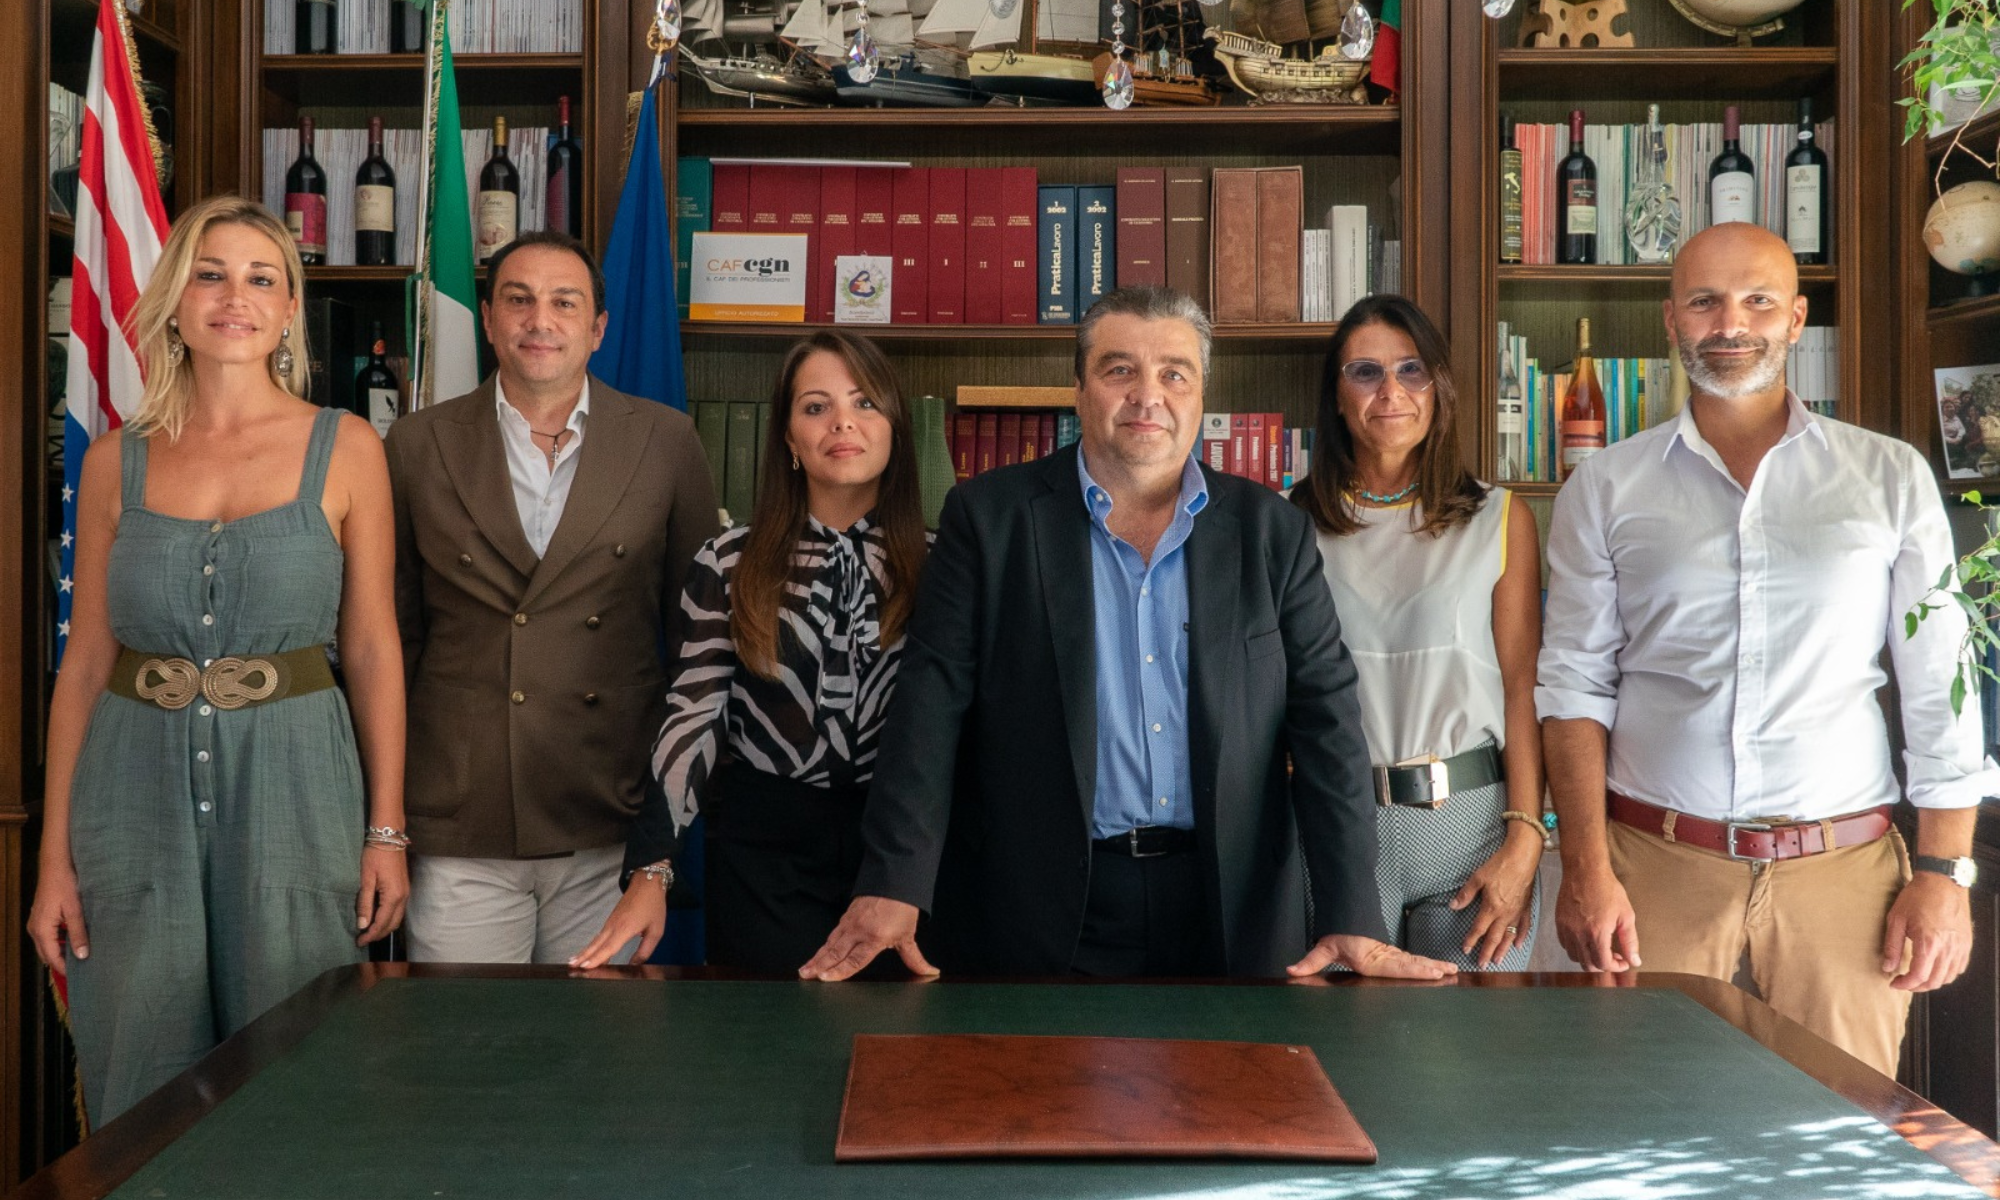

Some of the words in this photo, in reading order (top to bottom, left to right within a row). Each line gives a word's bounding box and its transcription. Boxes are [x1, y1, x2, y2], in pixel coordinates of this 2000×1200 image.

[1046, 206, 1067, 214] 2002
[903, 258, 915, 266] III
[1013, 260, 1025, 268] III
[707, 258, 742, 272] CAF
[743, 257, 790, 277] cgn
[1210, 441, 1224, 472] LAVORO
